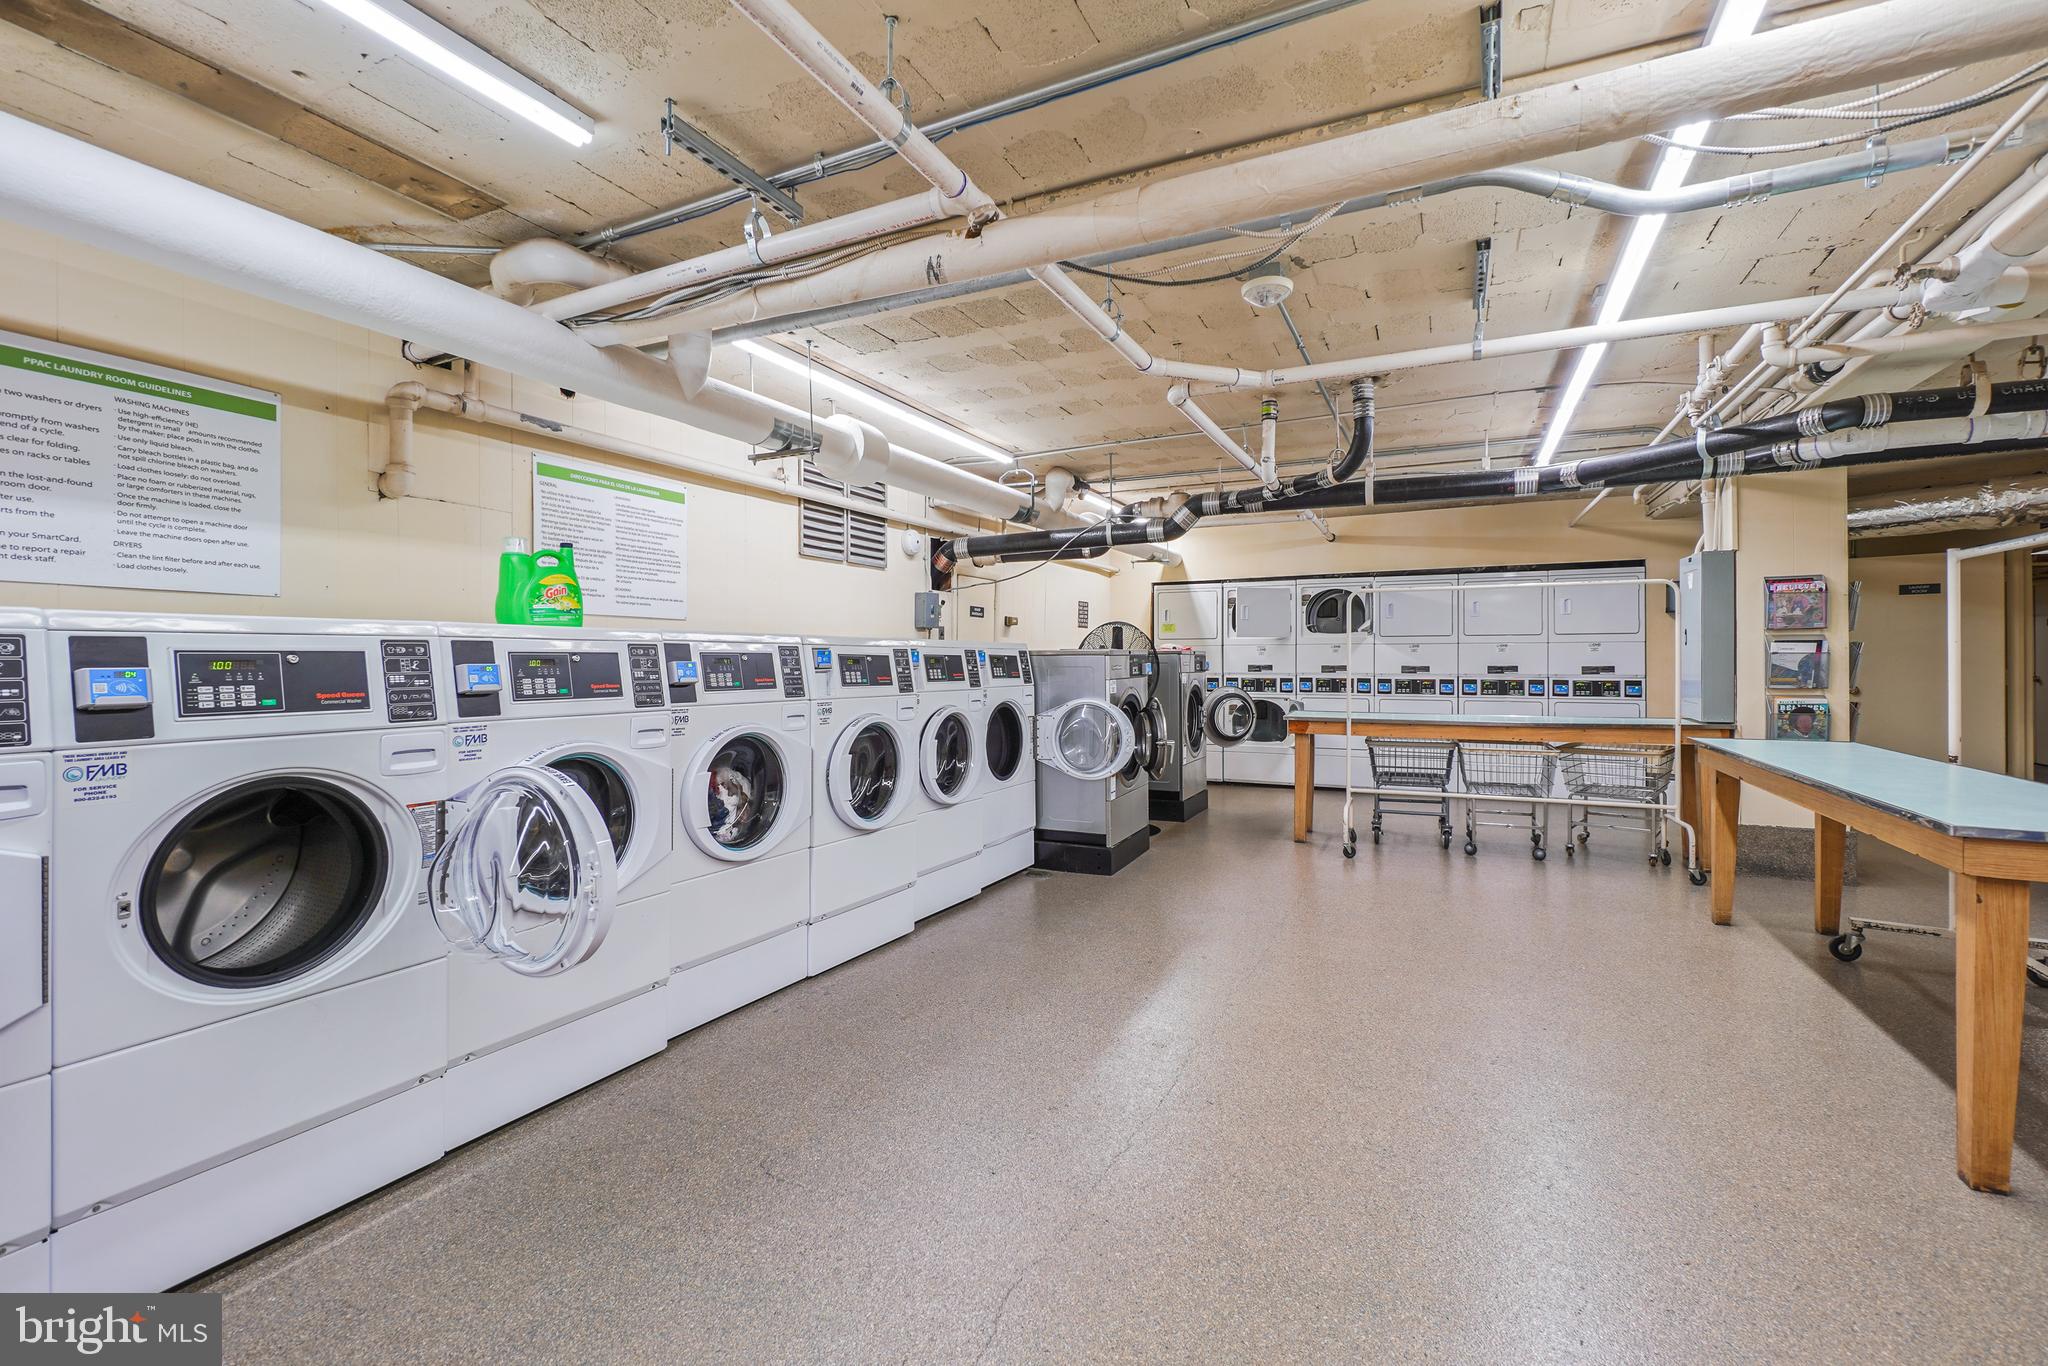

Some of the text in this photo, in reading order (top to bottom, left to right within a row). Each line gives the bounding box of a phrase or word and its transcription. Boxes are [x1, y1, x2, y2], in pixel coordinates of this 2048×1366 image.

[23, 357, 192, 398] PPAC LAUNDRY ROOM GUIDELINES
[4, 388, 23, 397] two
[24, 394, 62, 404] washers
[75, 402, 102, 412] dryers
[114, 396, 190, 416] WASHING MACHINES
[118, 408, 131, 416] Use
[41, 418, 100, 433] from washers
[118, 424, 127, 432] by
[118, 416, 153, 427] detergent
[188, 431, 217, 439] amounts
[218, 436, 263, 447] recommended
[6, 435, 29, 443] clear
[149, 440, 169, 448] liquid
[117, 445, 137, 454] Carry
[138, 448, 162, 457] bleach
[163, 452, 186, 461] bottles
[64, 457, 91, 465] tables
[117, 463, 135, 471] Load
[26, 473, 93, 487] lost-and-found
[126, 483, 145, 491] large
[146, 487, 183, 495] comforters
[177, 483, 212, 492] rubberized
[15, 508, 38, 516] from
[143, 514, 171, 522] attempt
[545, 586, 567, 598] Gain
[465, 734, 488, 747] FMB
[86, 763, 128, 781] FMB
